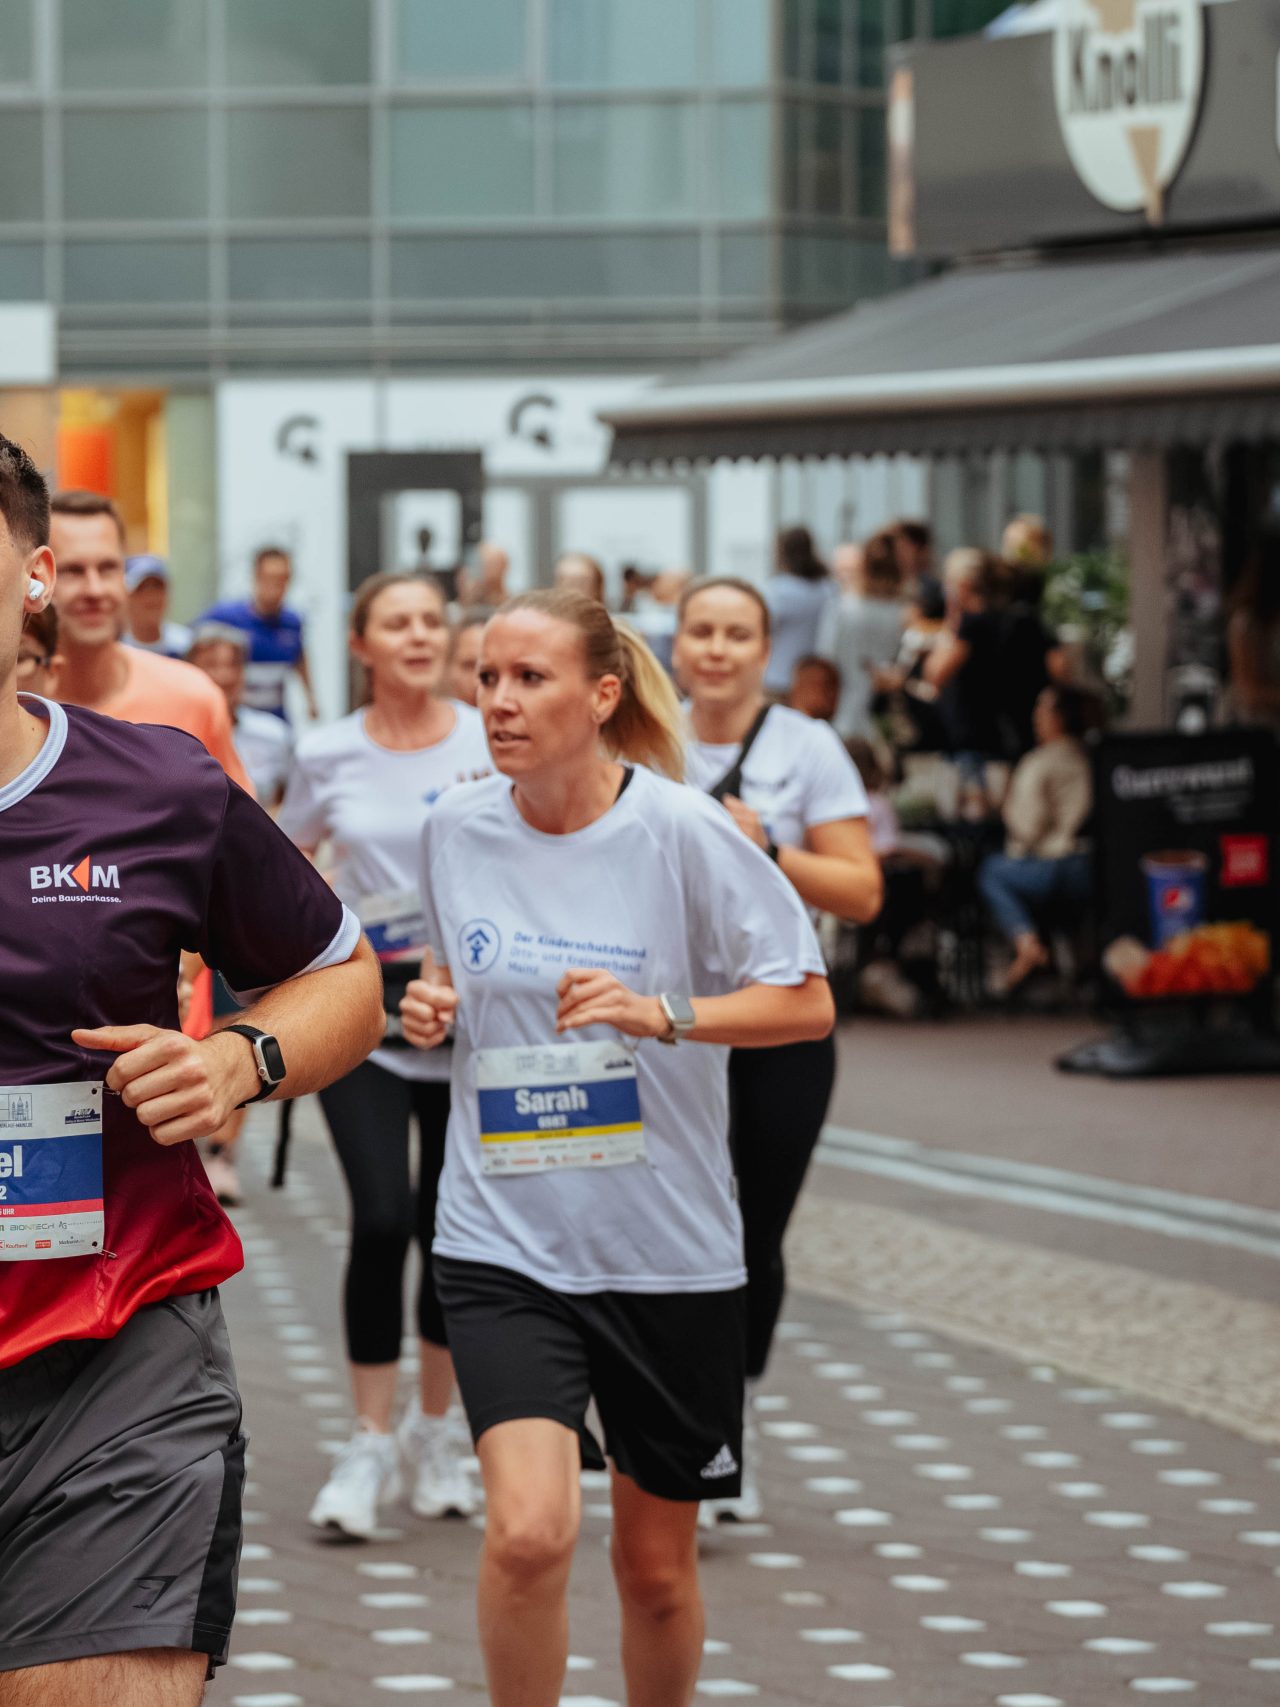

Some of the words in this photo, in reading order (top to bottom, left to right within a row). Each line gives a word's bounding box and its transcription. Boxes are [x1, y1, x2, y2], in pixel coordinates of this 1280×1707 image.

[1067, 9, 1182, 115] Knolli
[31, 895, 57, 904] Deine
[58, 894, 122, 904] Bausparkasse.
[513, 931, 534, 944] Der
[537, 934, 647, 959] Kinderschutzbund
[507, 960, 539, 976] Mainz
[541, 951, 563, 963] und
[514, 1084, 589, 1115] Sarah
